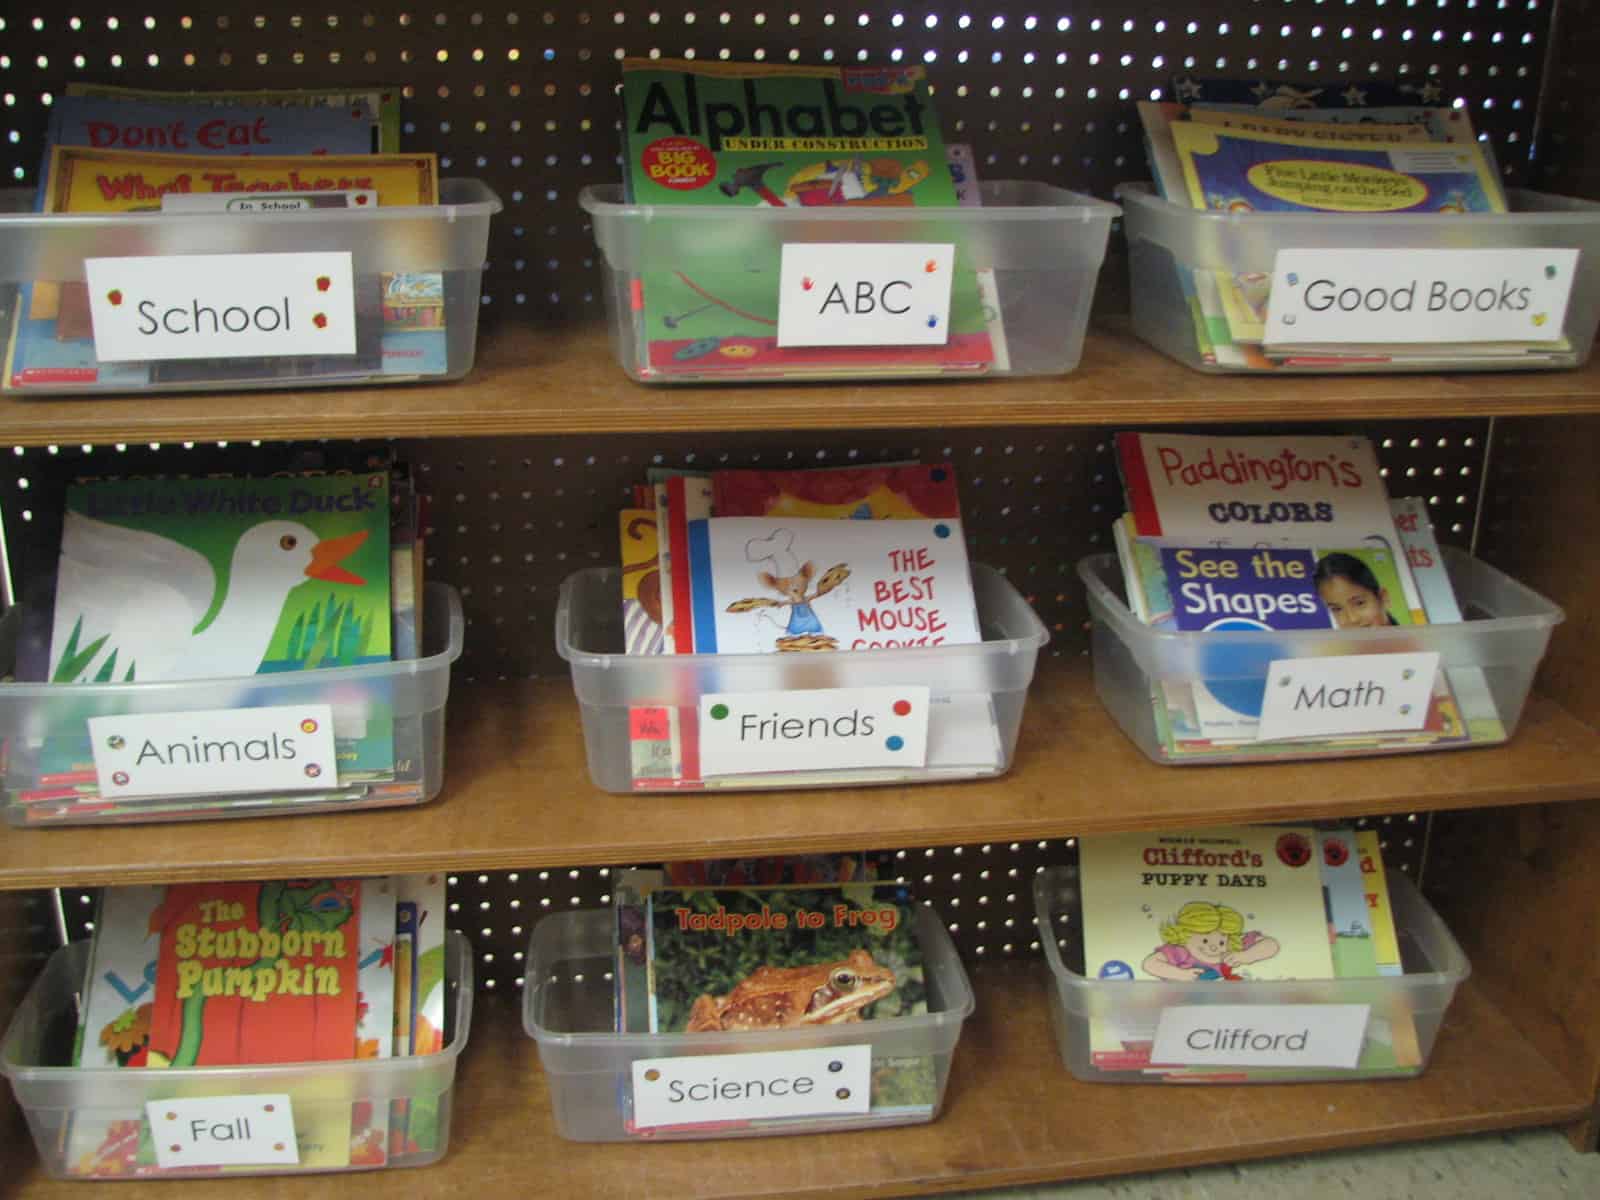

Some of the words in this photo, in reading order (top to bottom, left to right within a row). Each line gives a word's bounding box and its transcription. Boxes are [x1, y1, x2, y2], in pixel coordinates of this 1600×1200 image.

[636, 72, 925, 153] Alphabet
[196, 117, 272, 149] Eat
[725, 135, 786, 150] UNDER
[791, 134, 926, 150] CONSTRUCTION
[650, 162, 711, 179] BOOK
[657, 151, 697, 165] BIG
[261, 201, 302, 210] School
[819, 280, 914, 315] ABC
[1303, 279, 1417, 312] Good
[1427, 280, 1532, 312] Books
[138, 296, 291, 335] School
[288, 485, 377, 515] Duck
[1207, 501, 1334, 525] COLORS
[887, 547, 936, 573] THE
[1175, 550, 1239, 579] See
[1252, 551, 1307, 579] the
[874, 575, 935, 604] BEST
[1180, 582, 1319, 622] Shapes
[857, 606, 947, 633] MOUSE
[1294, 680, 1385, 711] Math
[740, 709, 876, 742] Friends
[136, 732, 297, 766] Animals
[1143, 847, 1263, 868] Clifford's
[1141, 872, 1208, 887] PUPPY
[1216, 873, 1267, 888] DAYS
[199, 900, 245, 923] The
[675, 904, 788, 936] Tadpole
[797, 908, 825, 927] to
[833, 904, 898, 931] Frog
[175, 923, 347, 959] Stubborn
[175, 958, 342, 1002] Pumpkin
[1186, 1028, 1310, 1052] Clifford
[668, 1074, 814, 1103] Science
[190, 1117, 251, 1142] Fall
